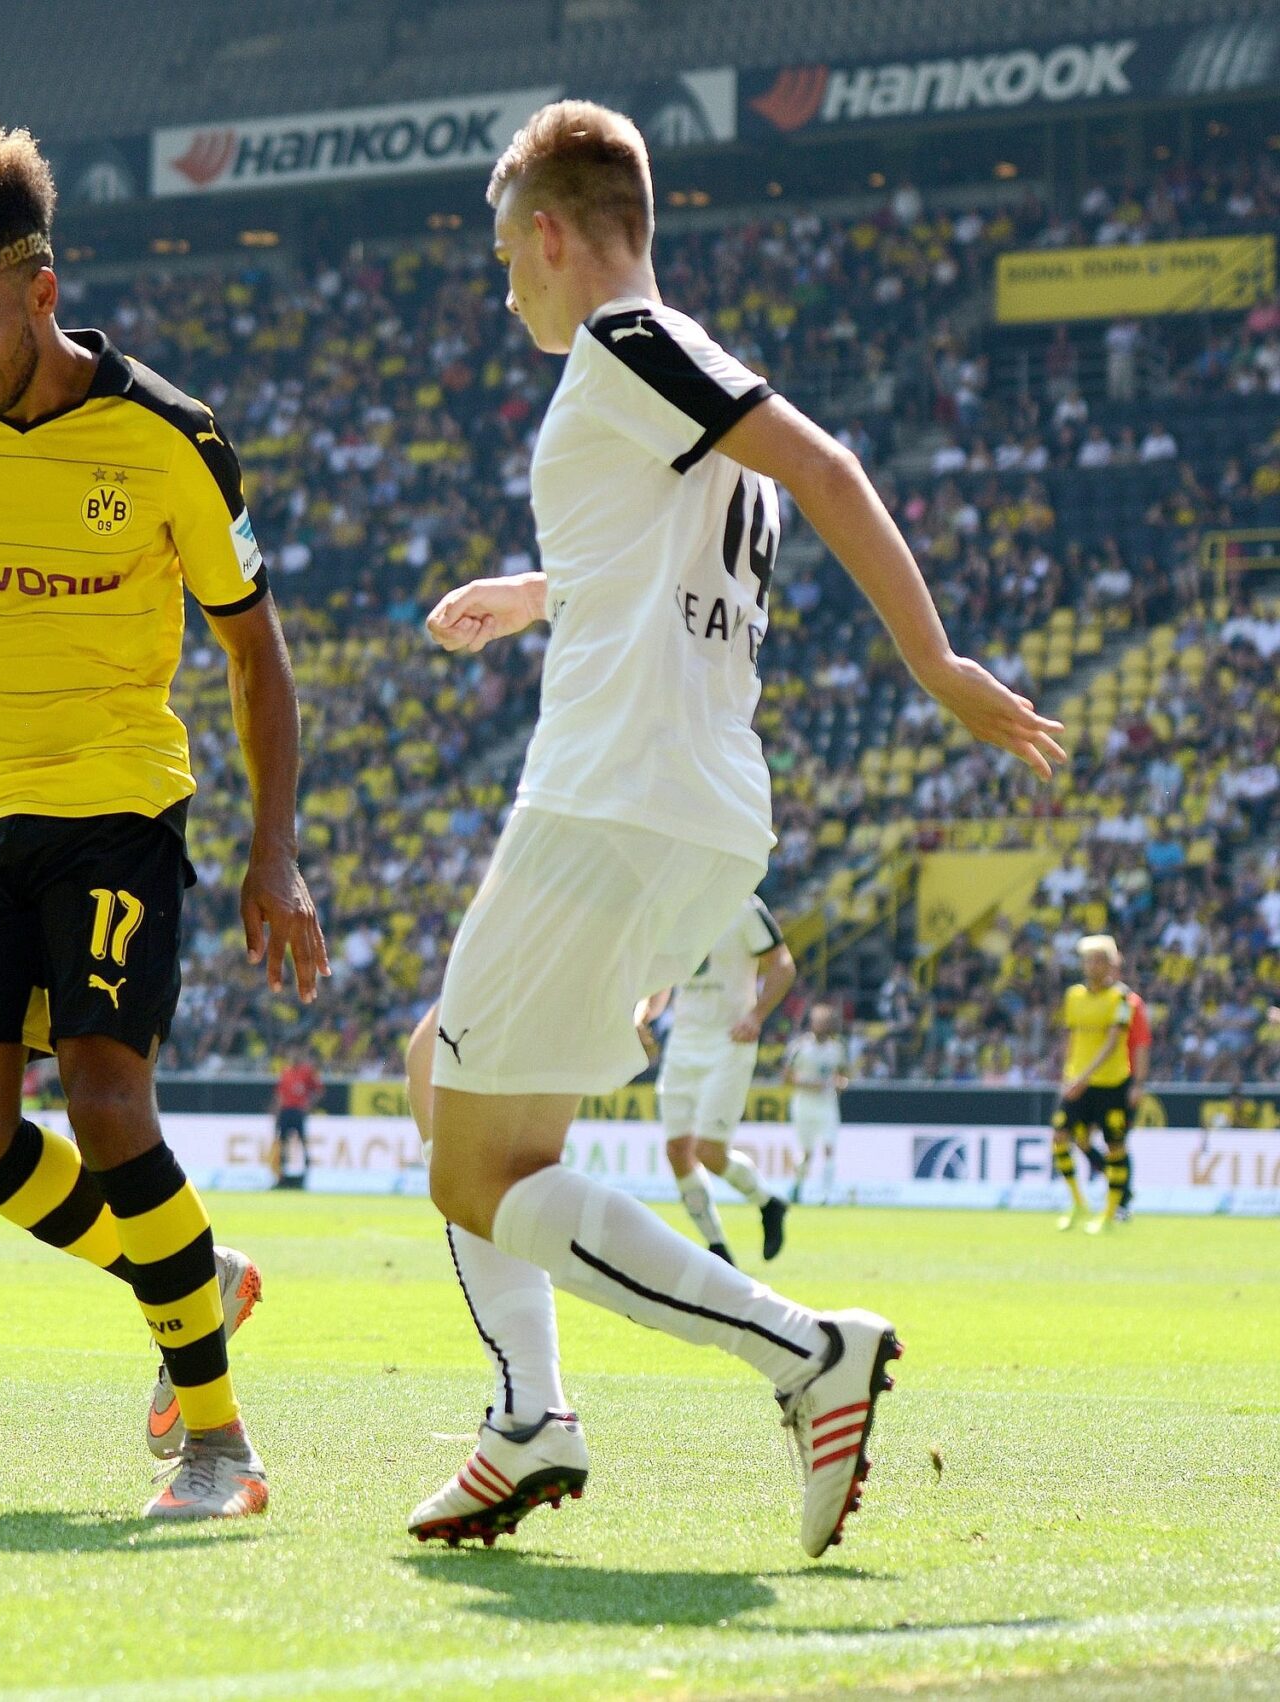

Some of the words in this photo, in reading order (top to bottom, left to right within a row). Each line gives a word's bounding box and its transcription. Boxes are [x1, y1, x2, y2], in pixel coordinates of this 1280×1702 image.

[87, 488, 128, 521] BVB
[97, 520, 113, 532] 09
[723, 466, 774, 612] 14
[88, 888, 145, 967] 17
